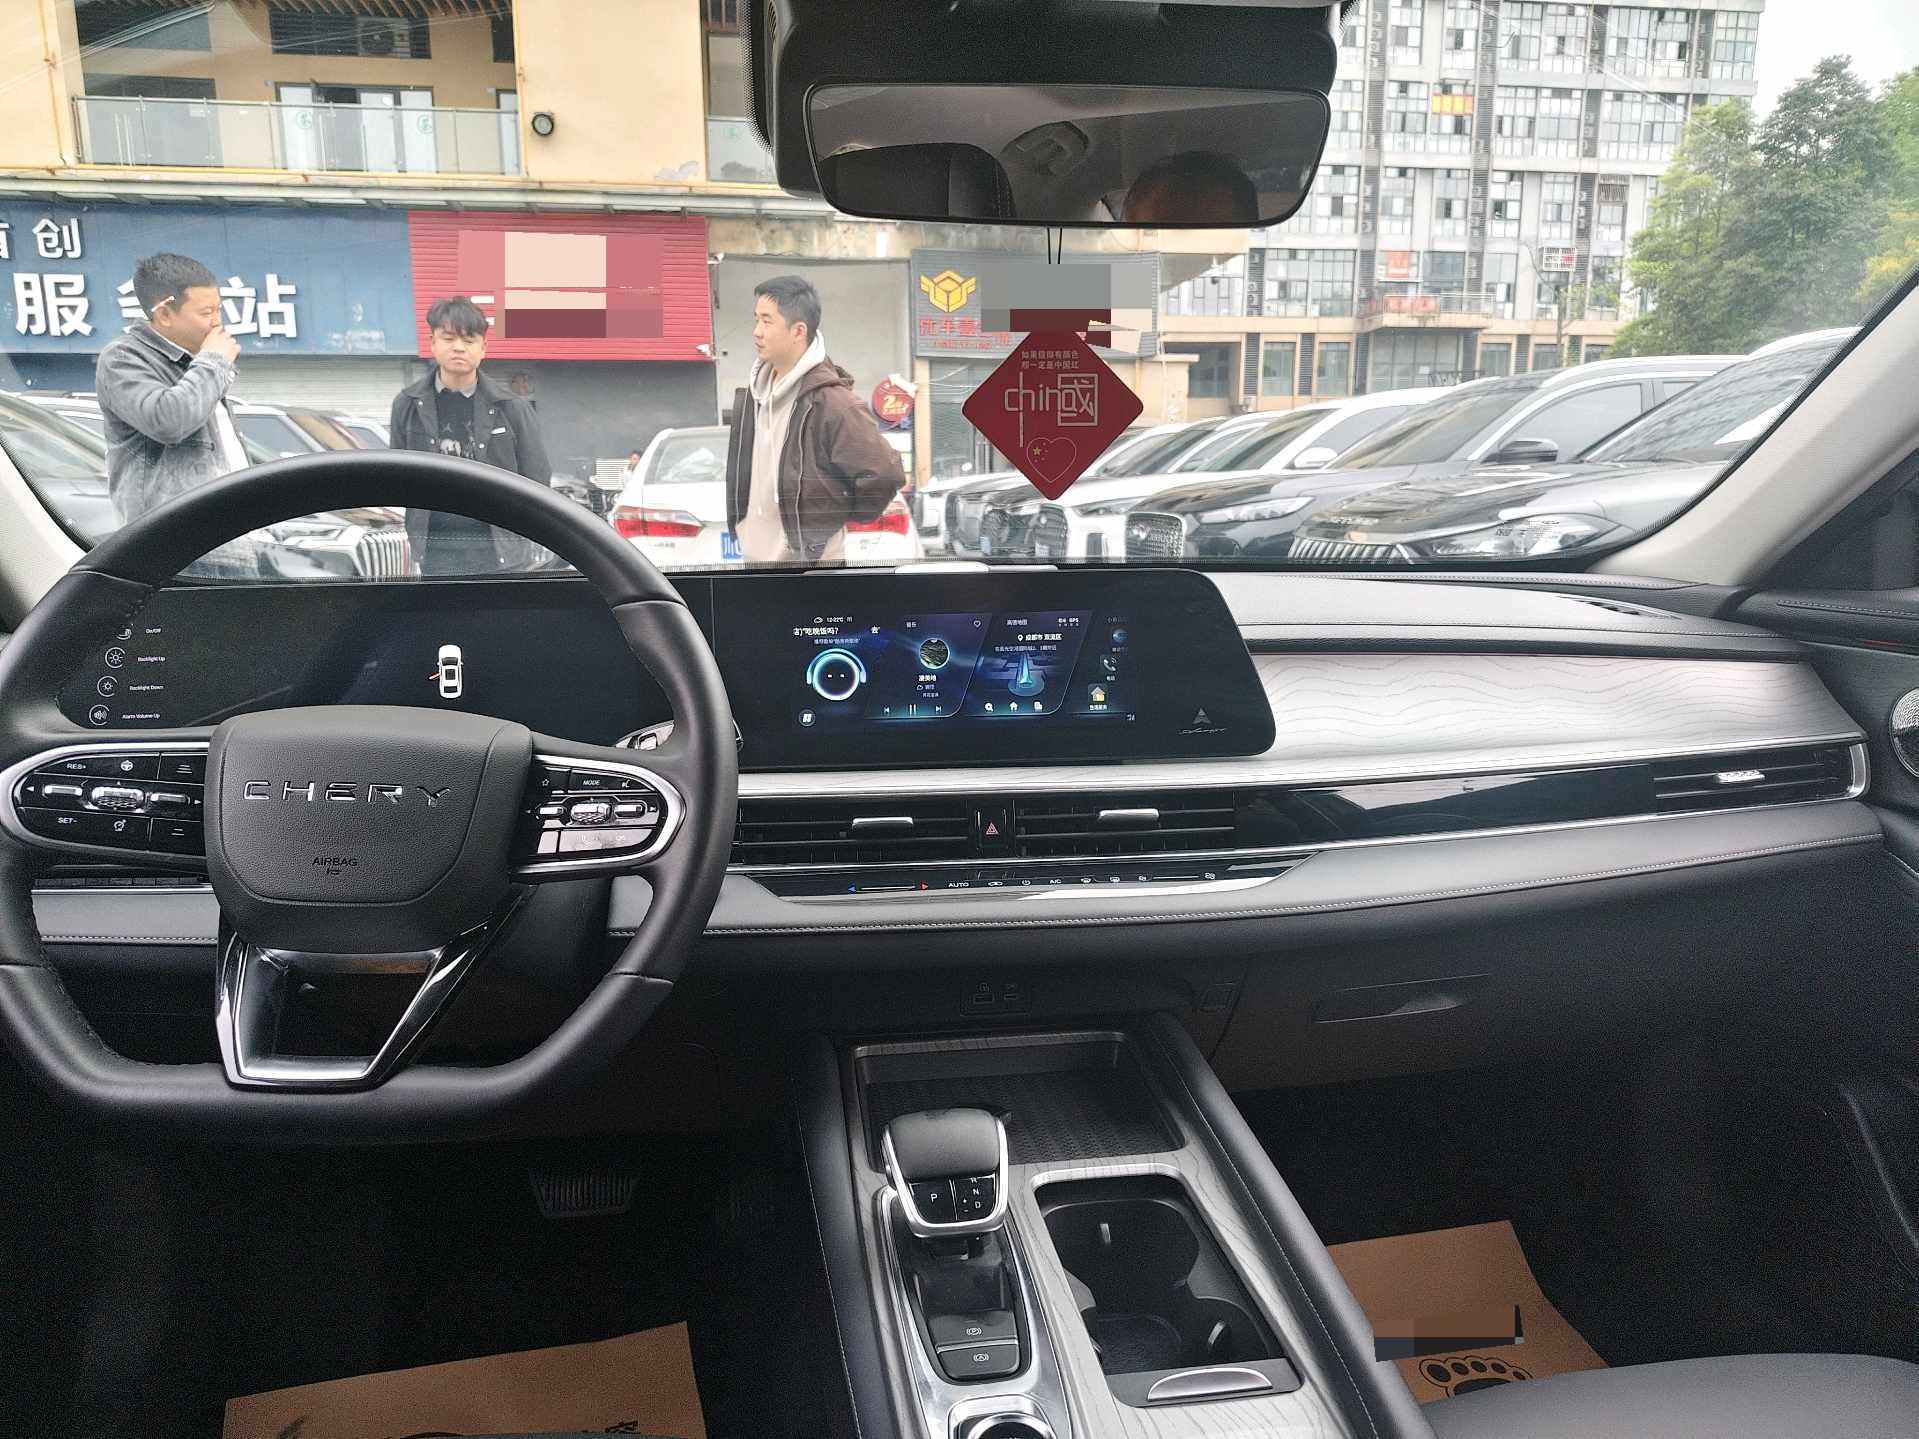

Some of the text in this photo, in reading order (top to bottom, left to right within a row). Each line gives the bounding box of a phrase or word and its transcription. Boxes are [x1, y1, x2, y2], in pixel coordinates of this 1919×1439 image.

[0, 217, 82, 260] 创
[243, 780, 451, 807] CHERY
[312, 857, 358, 867] AIRBAG
[930, 1193, 938, 1202] P
